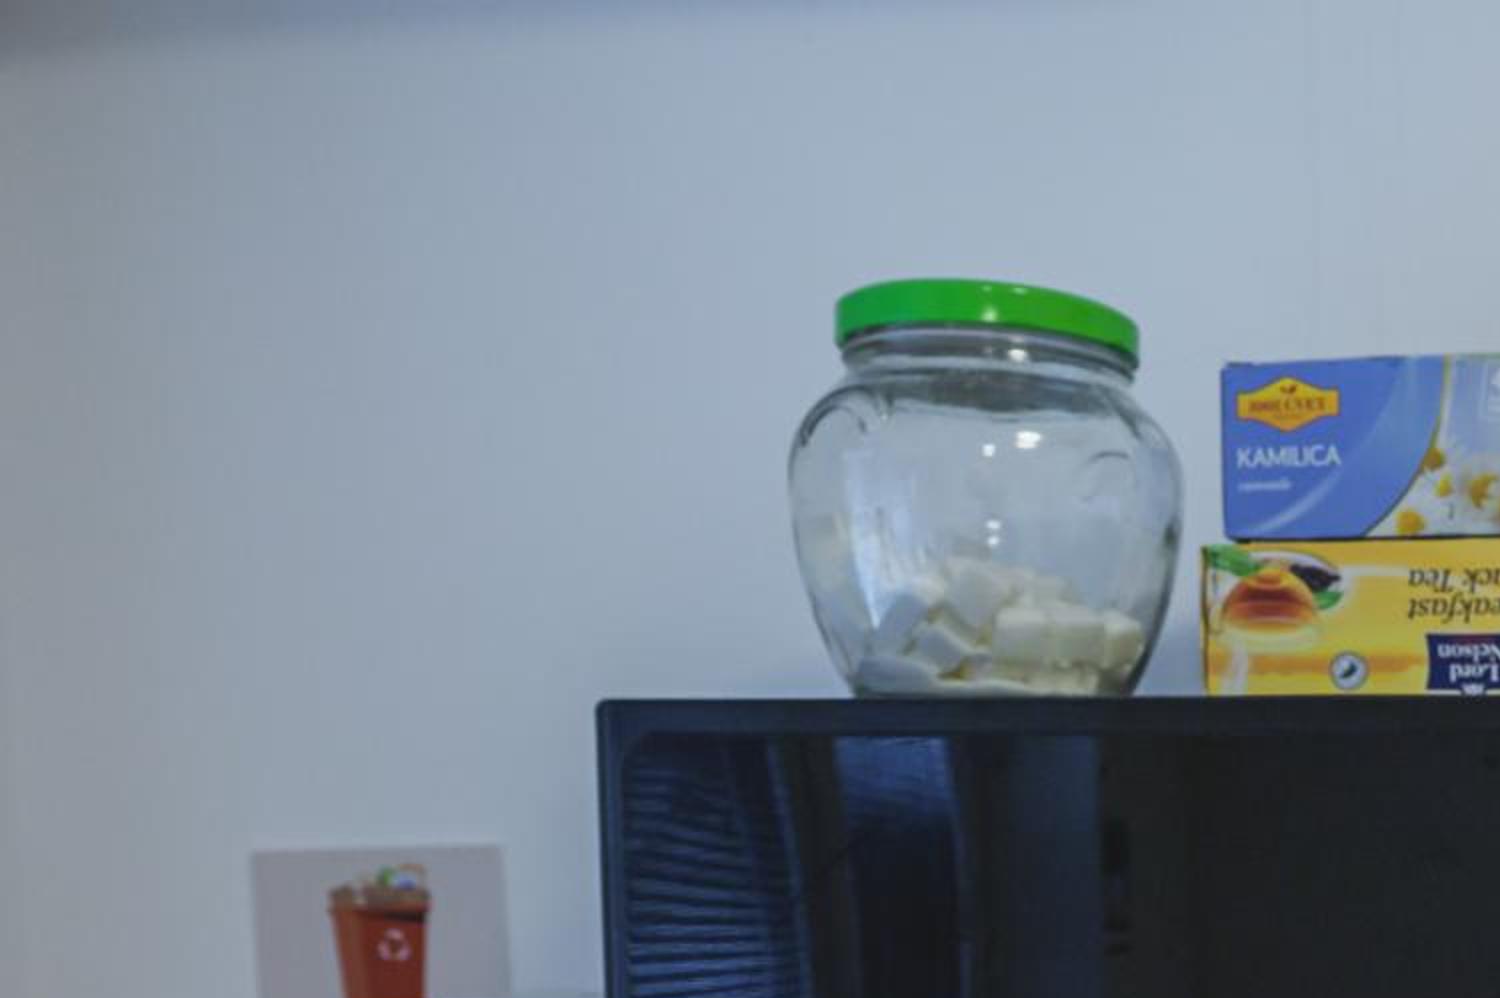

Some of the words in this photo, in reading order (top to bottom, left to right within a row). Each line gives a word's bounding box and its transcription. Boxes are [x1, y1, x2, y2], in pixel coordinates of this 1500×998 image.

[1236, 444, 1342, 469] KAMILICA
[1408, 568, 1452, 593] Tea
[1449, 663, 1499, 683] Lord
